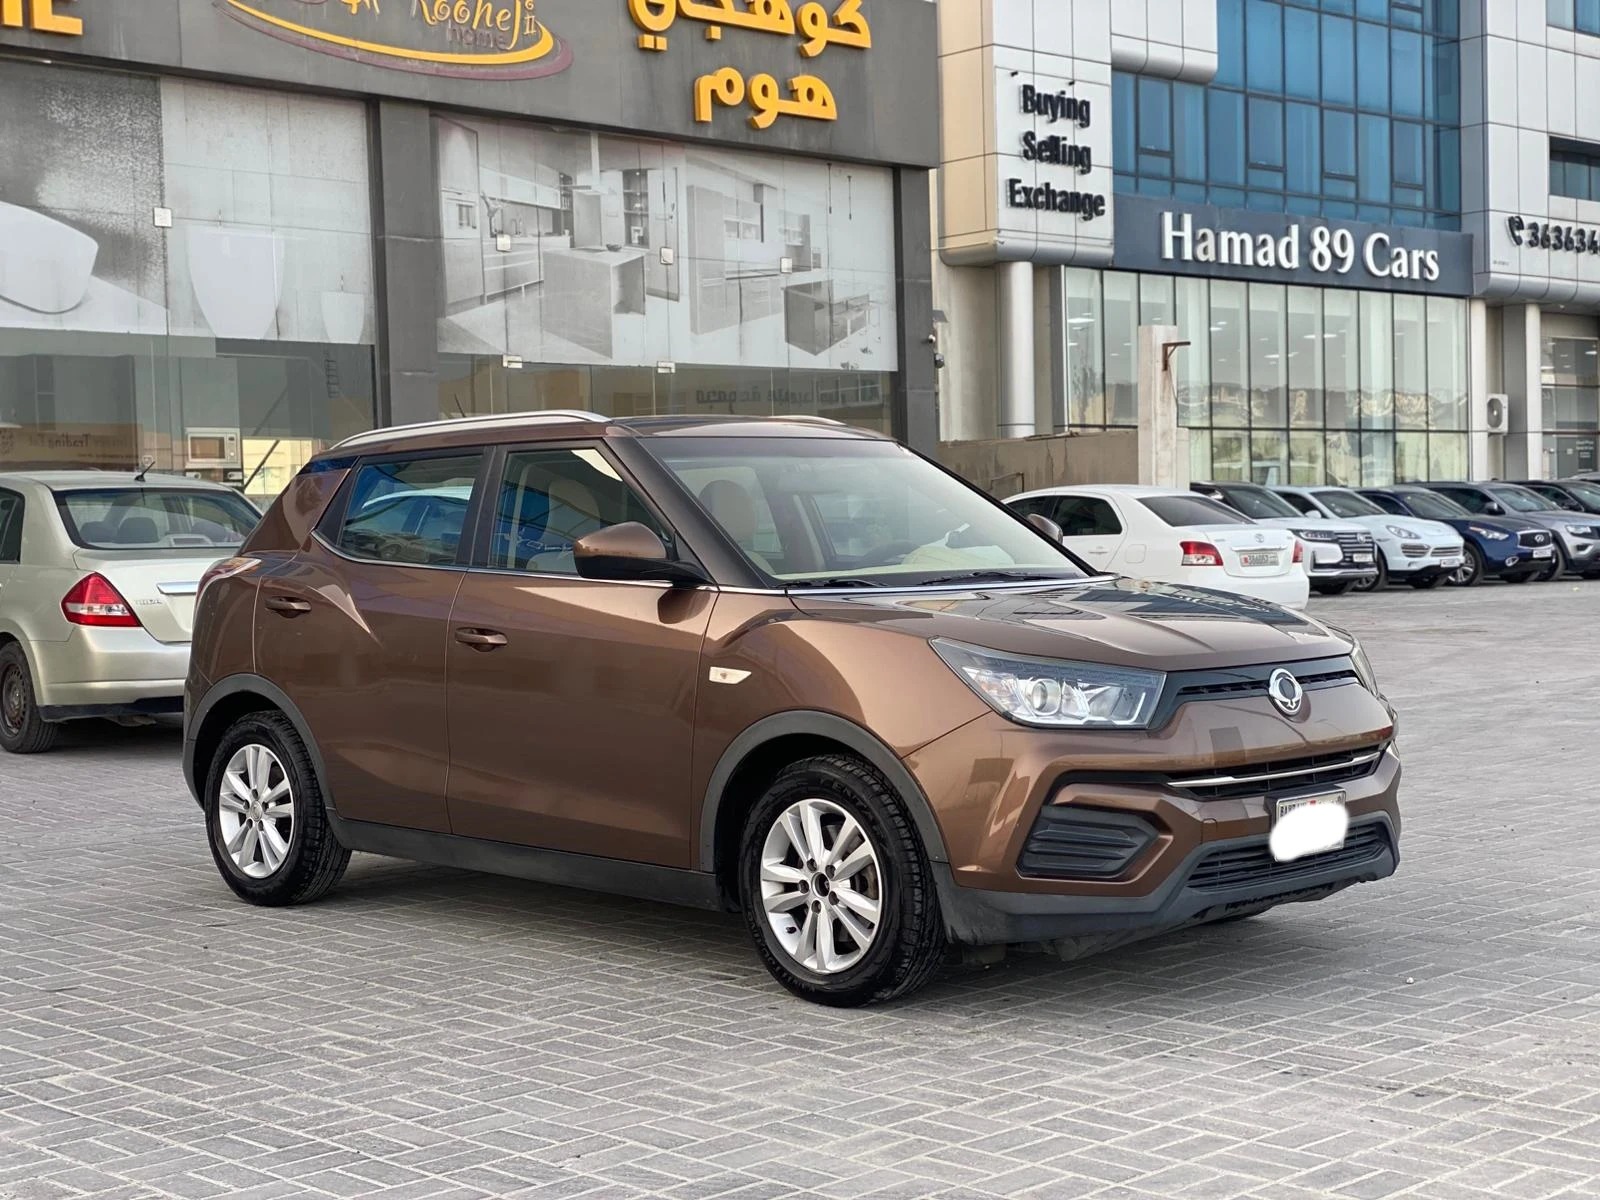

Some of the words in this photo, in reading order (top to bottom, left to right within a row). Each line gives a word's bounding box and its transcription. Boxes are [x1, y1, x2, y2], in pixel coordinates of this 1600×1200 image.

[694, 66, 838, 129] هوم
[1021, 84, 1091, 128] Buying
[1021, 130, 1092, 175] Selling
[1007, 178, 1105, 221] Exchange
[1161, 211, 1300, 270] Hamad
[1309, 225, 1355, 274] 89
[1363, 231, 1440, 281] Cars
[1526, 221, 1600, 255] 363634
